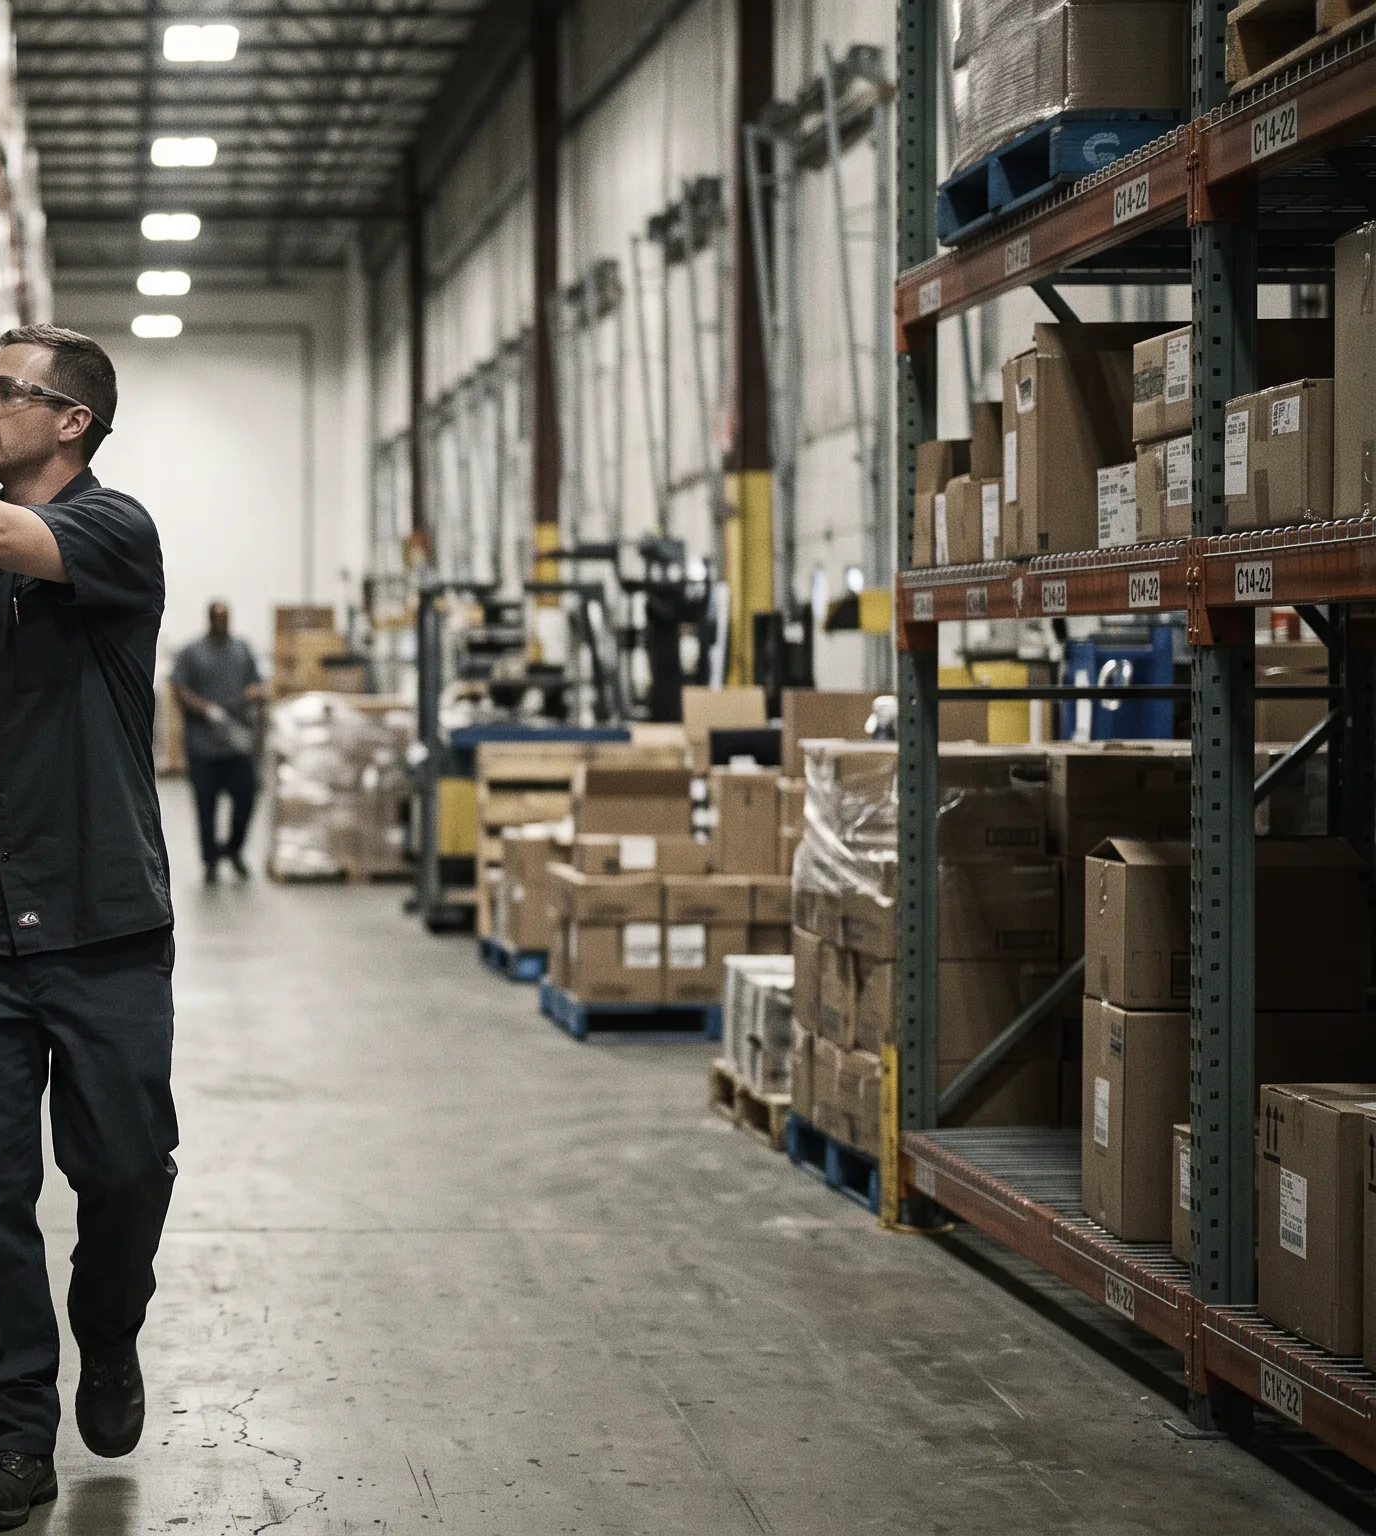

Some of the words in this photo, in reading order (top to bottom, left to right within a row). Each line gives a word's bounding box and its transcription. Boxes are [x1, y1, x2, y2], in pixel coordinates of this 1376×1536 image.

[1254, 107, 1295, 155] C14-22
[1116, 181, 1146, 218] C14-22
[1237, 567, 1271, 595] C14-22
